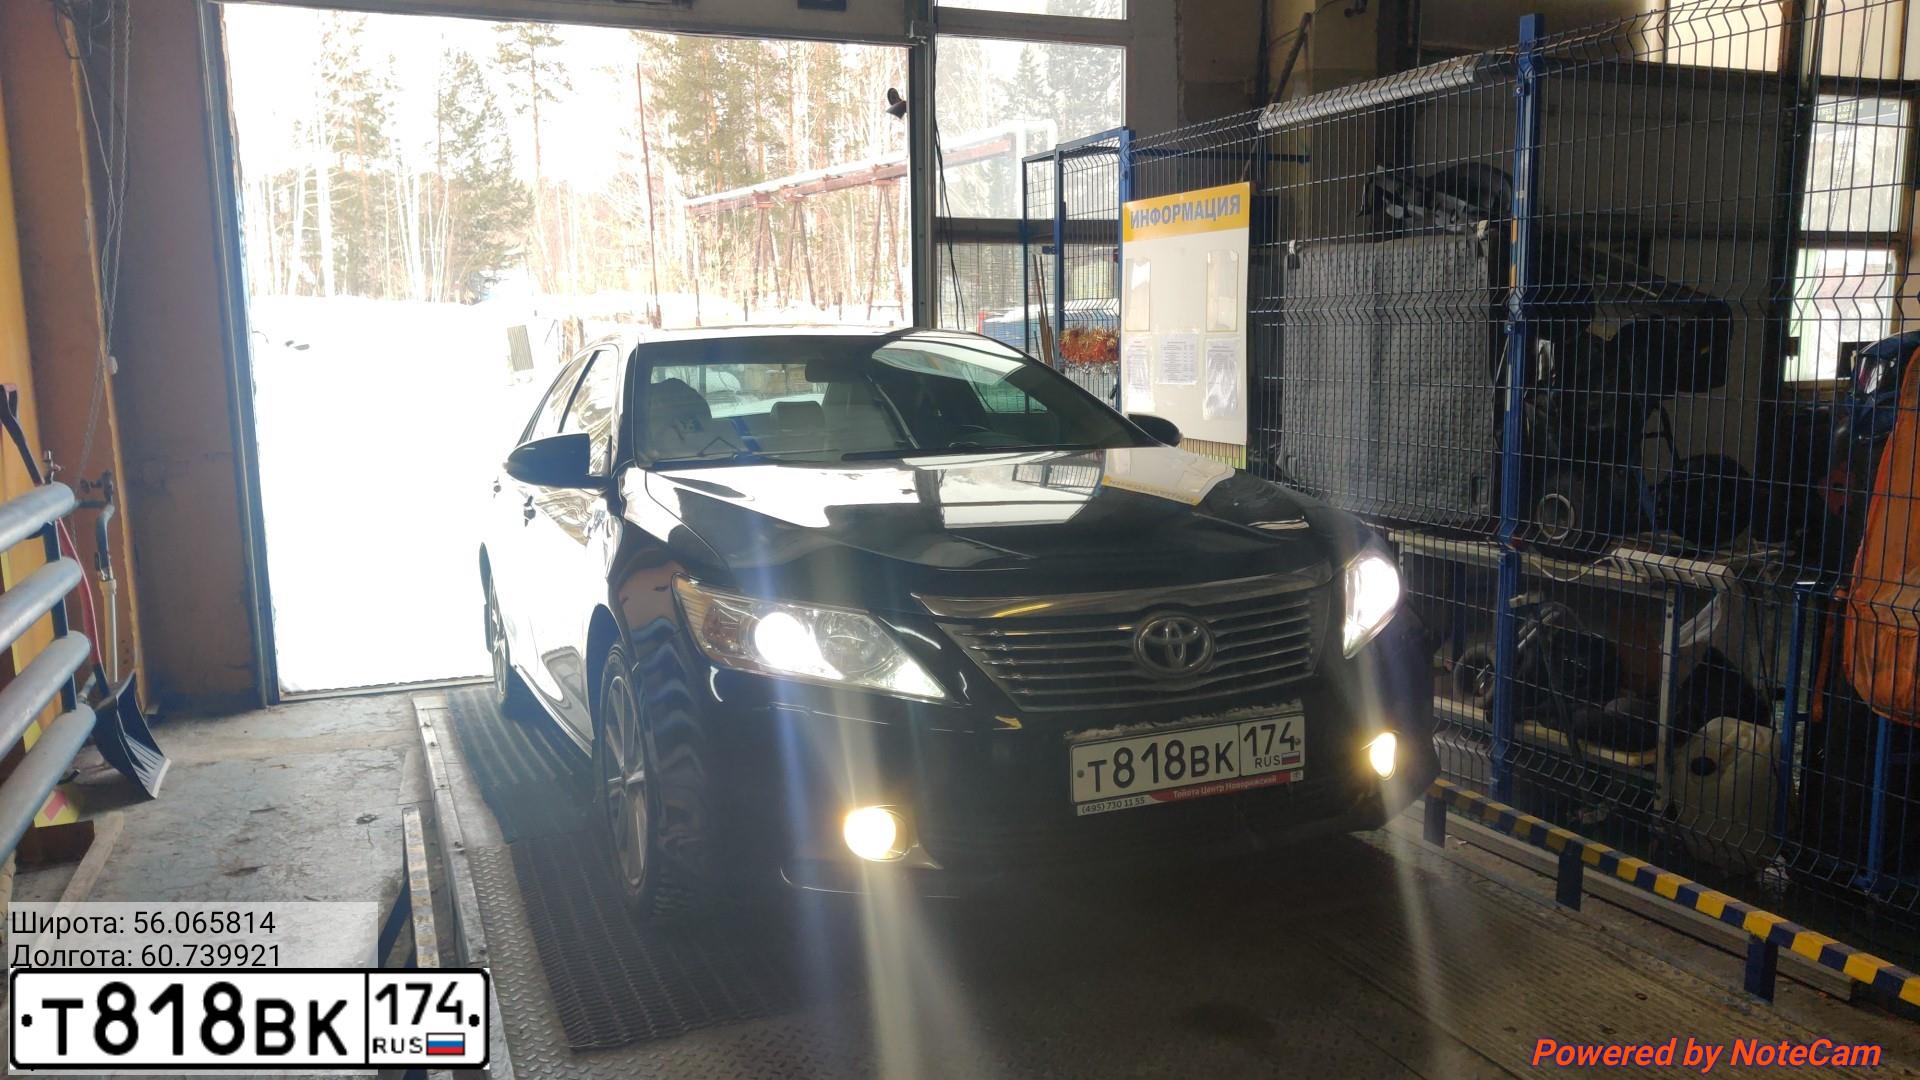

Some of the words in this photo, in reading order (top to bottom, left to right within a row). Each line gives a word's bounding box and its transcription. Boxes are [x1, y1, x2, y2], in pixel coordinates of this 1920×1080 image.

[1130, 194, 1241, 229] ИНФОРМАЦИЯ
[1087, 739, 1234, 793] Т818ВК
[1243, 721, 1295, 757] 174
[1254, 754, 1281, 769] RUS
[1201, 784, 1225, 796] Центр
